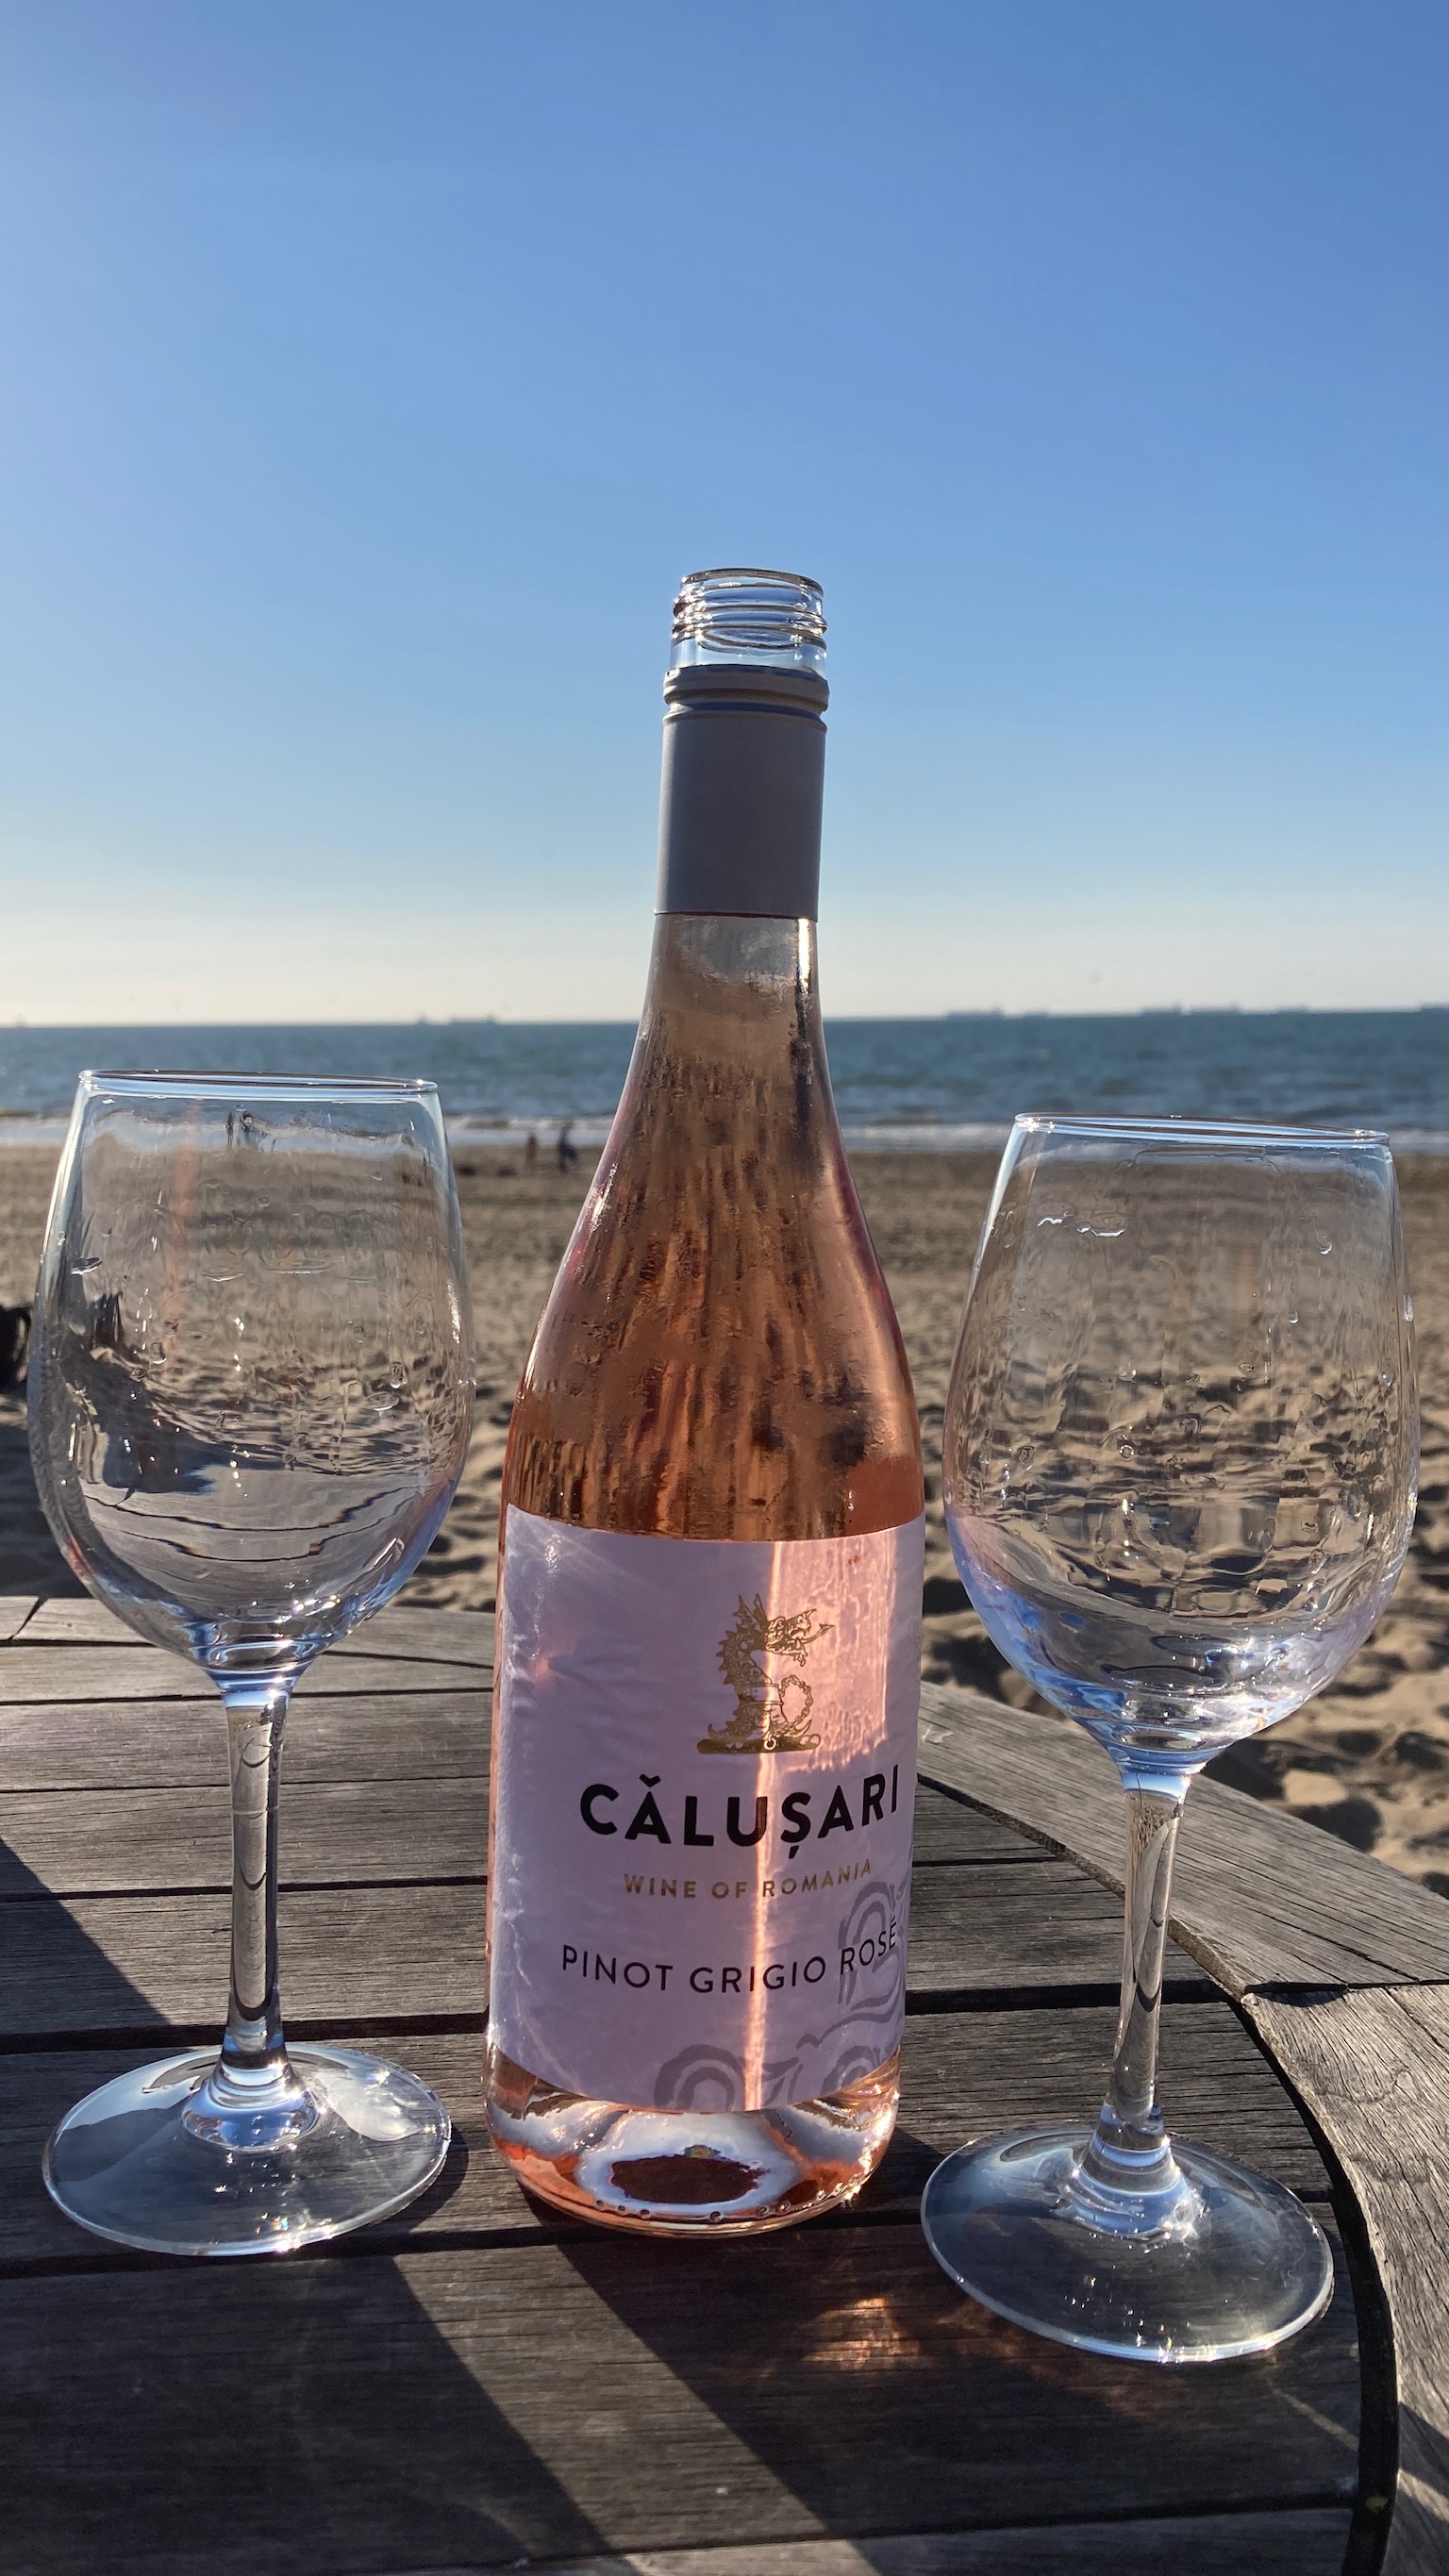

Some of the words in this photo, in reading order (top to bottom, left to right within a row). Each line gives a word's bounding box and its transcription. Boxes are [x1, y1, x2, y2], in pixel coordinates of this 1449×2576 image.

[624, 1872, 696, 1899] WINE
[711, 1880, 747, 1899] OF
[762, 1858, 873, 1899] ROMANIA
[562, 1944, 674, 1992] PINOT
[690, 1956, 826, 1995] GRIGIO
[840, 1916, 897, 1975] ROSÉ
